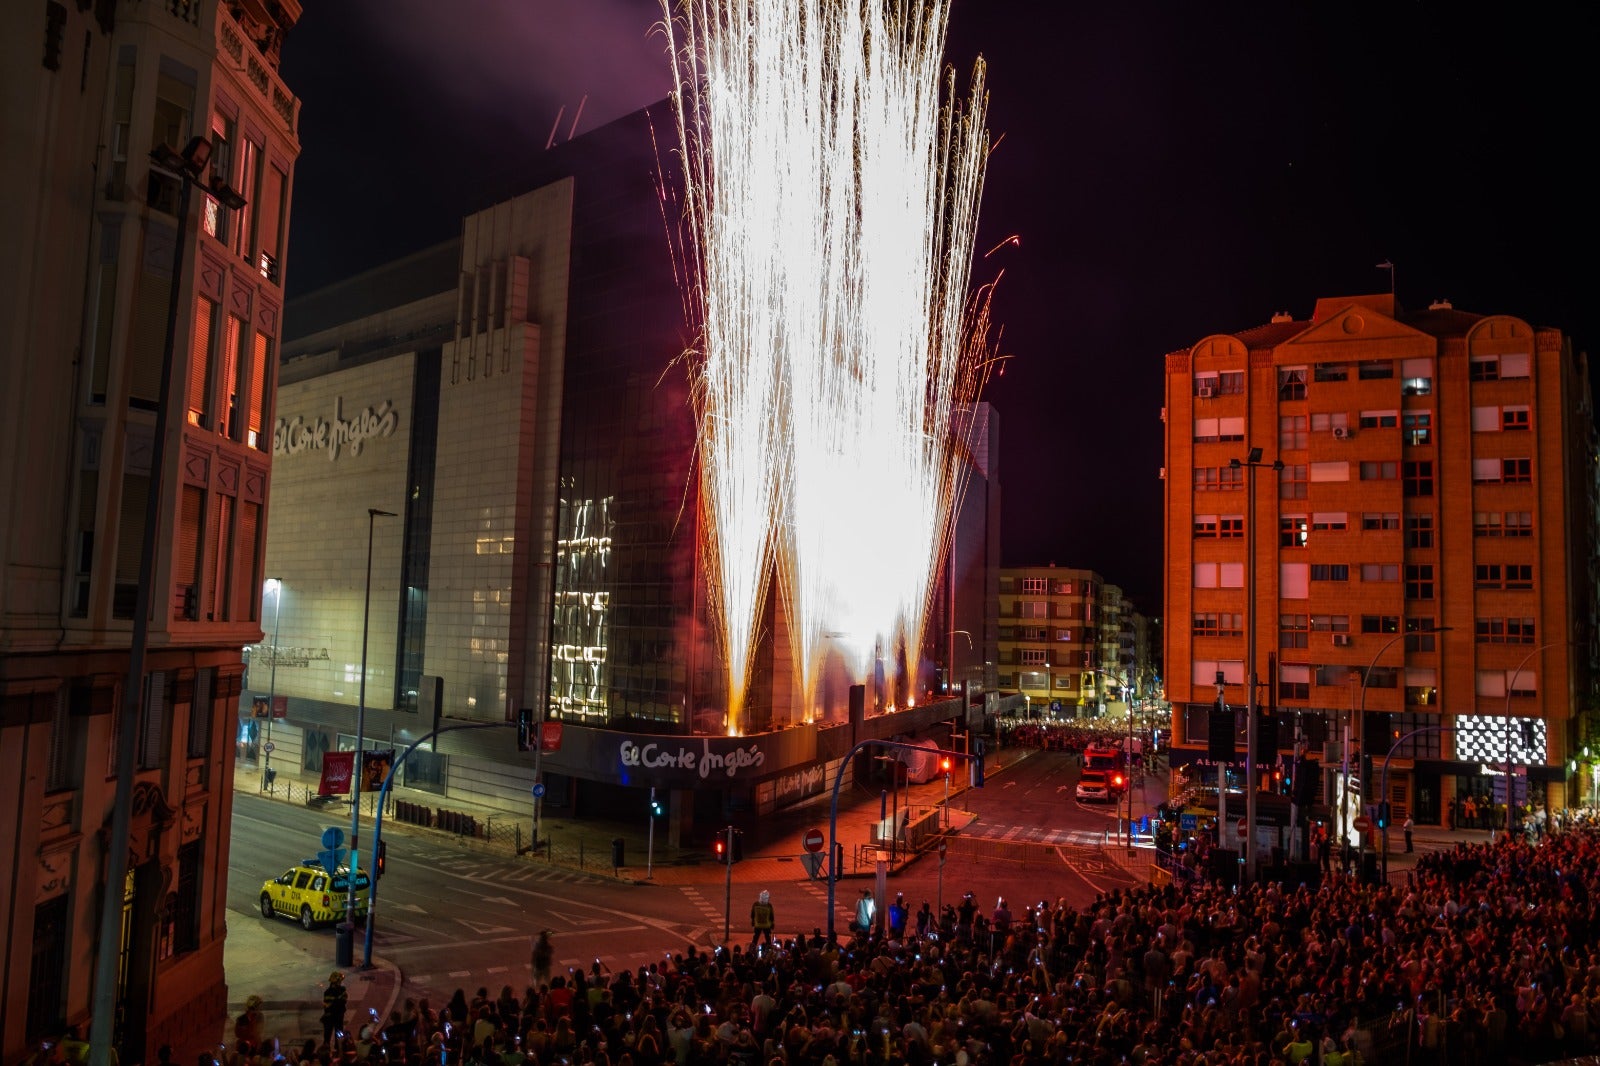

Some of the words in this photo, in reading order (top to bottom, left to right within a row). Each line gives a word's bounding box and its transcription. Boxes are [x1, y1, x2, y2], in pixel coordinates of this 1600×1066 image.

[287, 415, 329, 455] Corte
[329, 395, 398, 462] Inglés
[619, 740, 640, 766] El
[641, 743, 696, 769] Corte
[698, 738, 765, 779] Inglés
[1196, 758, 1235, 768] AEDS
